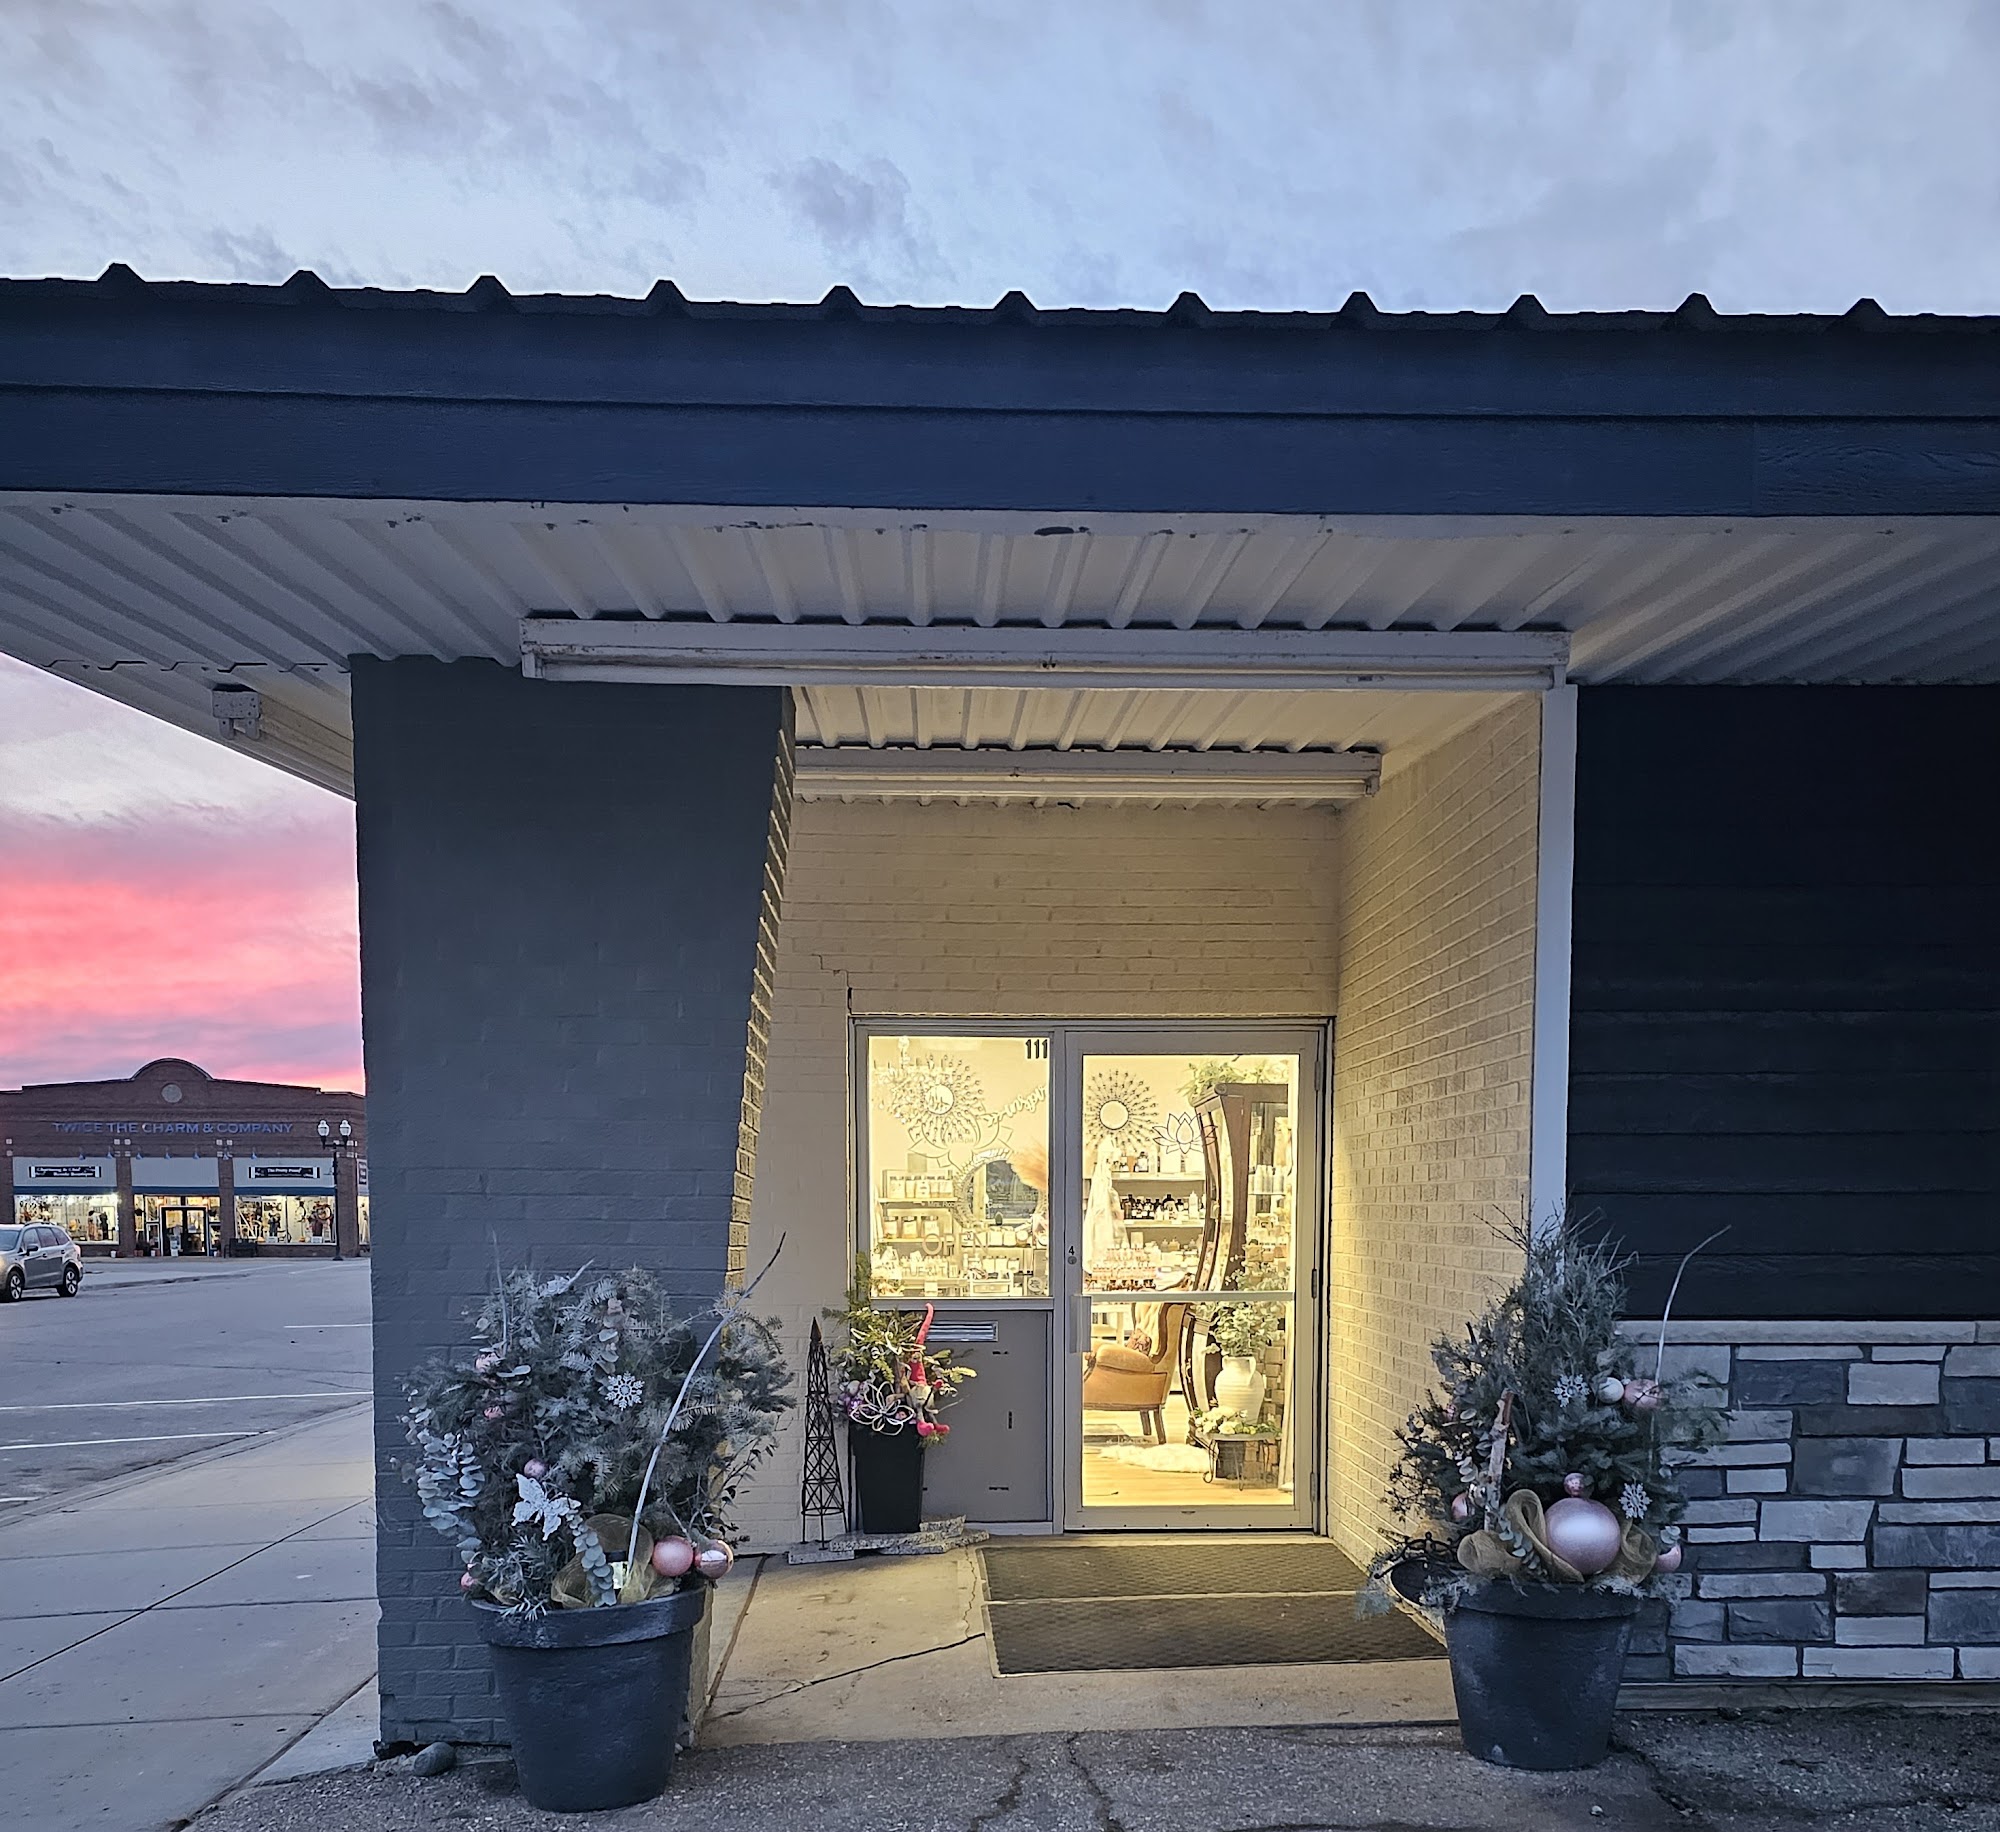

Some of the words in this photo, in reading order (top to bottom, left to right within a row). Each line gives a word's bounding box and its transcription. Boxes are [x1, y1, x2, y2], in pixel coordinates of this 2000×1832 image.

[1025, 1039, 1048, 1059] 111
[52, 1122, 103, 1133] TWICE
[106, 1122, 139, 1133] THE
[142, 1122, 199, 1133] CHARM
[202, 1123, 213, 1133] &
[217, 1123, 293, 1133] COMPANY
[921, 1232, 989, 1256] OPEN
[1068, 1245, 1075, 1256] 4
